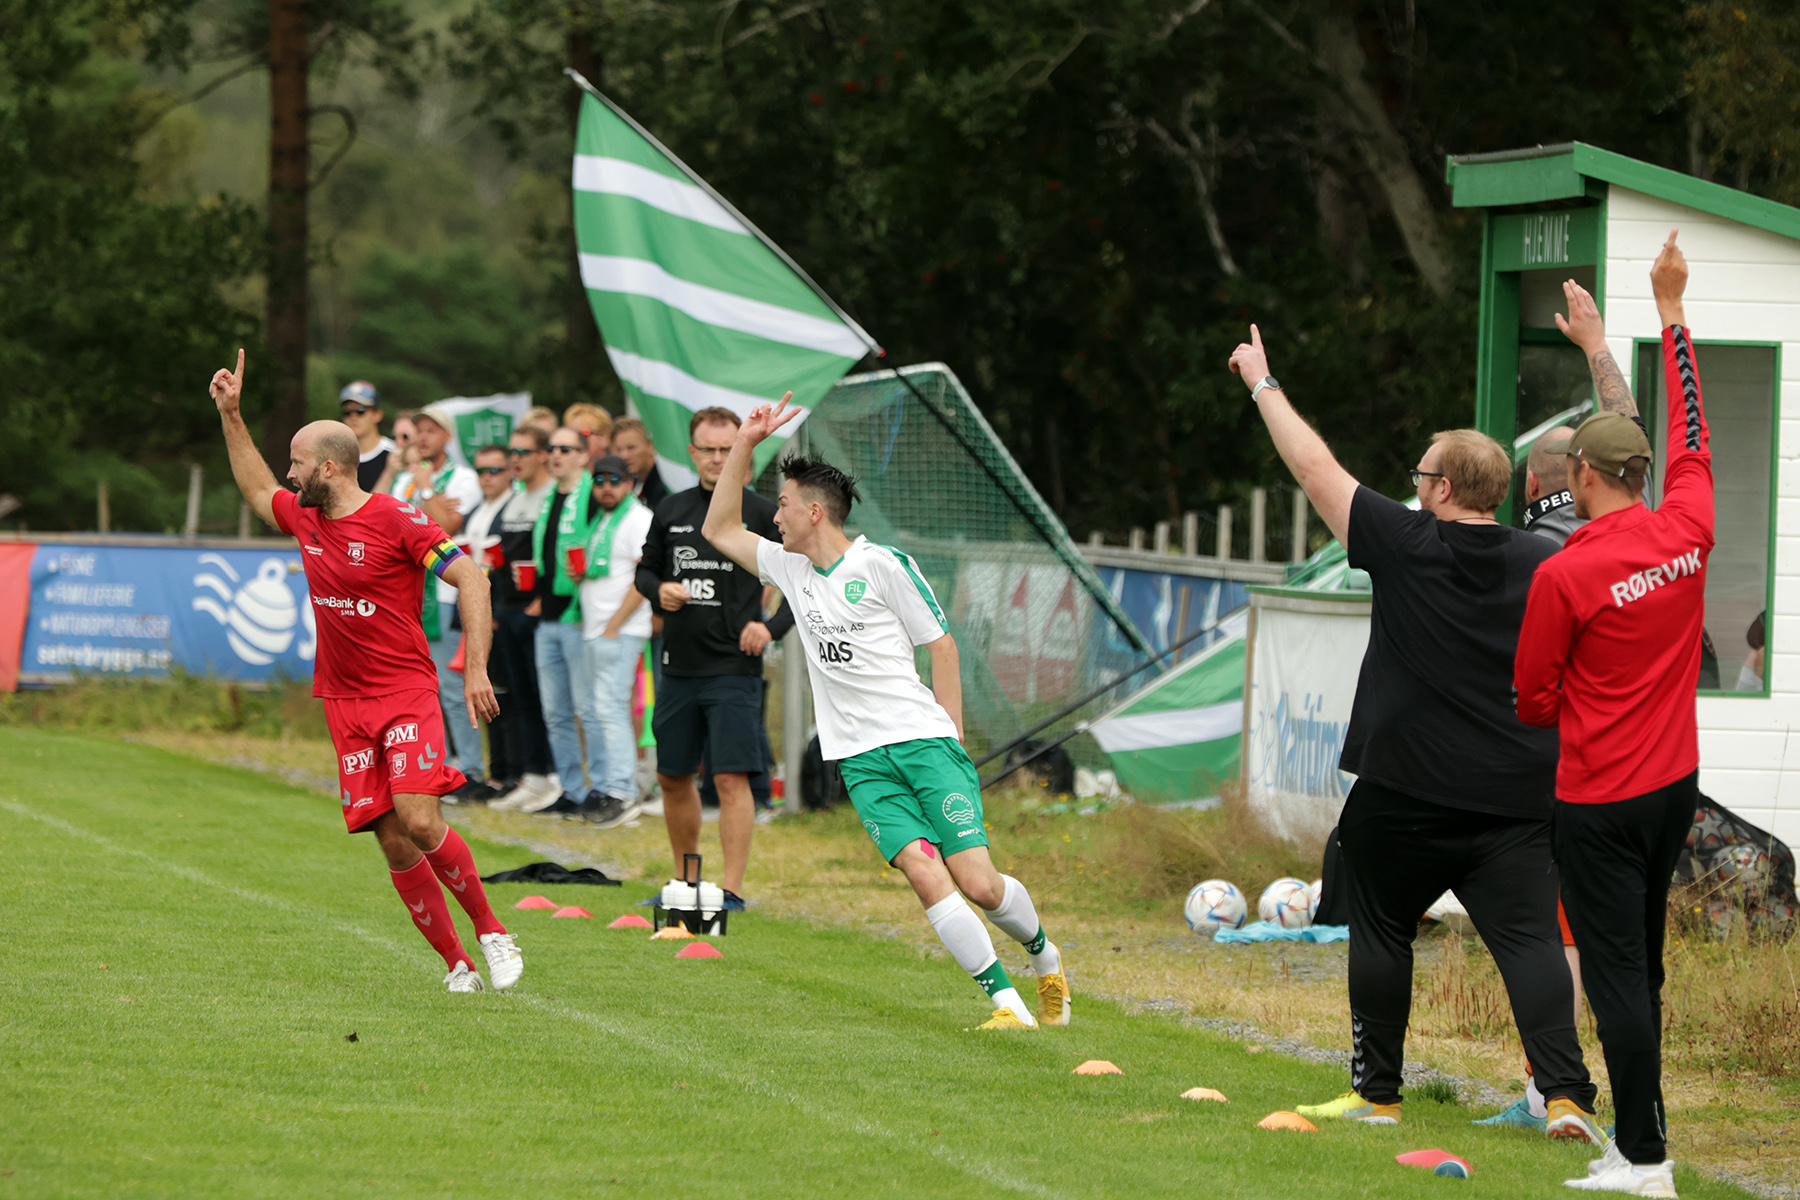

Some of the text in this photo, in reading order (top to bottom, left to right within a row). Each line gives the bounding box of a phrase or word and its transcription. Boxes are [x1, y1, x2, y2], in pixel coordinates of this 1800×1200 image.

[1522, 214, 1570, 264] HJEMME
[1540, 491, 1573, 512] PER
[848, 583, 863, 593] FIL
[1610, 547, 1703, 608] RØRVIK
[850, 622, 865, 632] AS
[818, 640, 854, 664] AQS
[384, 725, 416, 747] PM
[345, 750, 375, 772] PM
